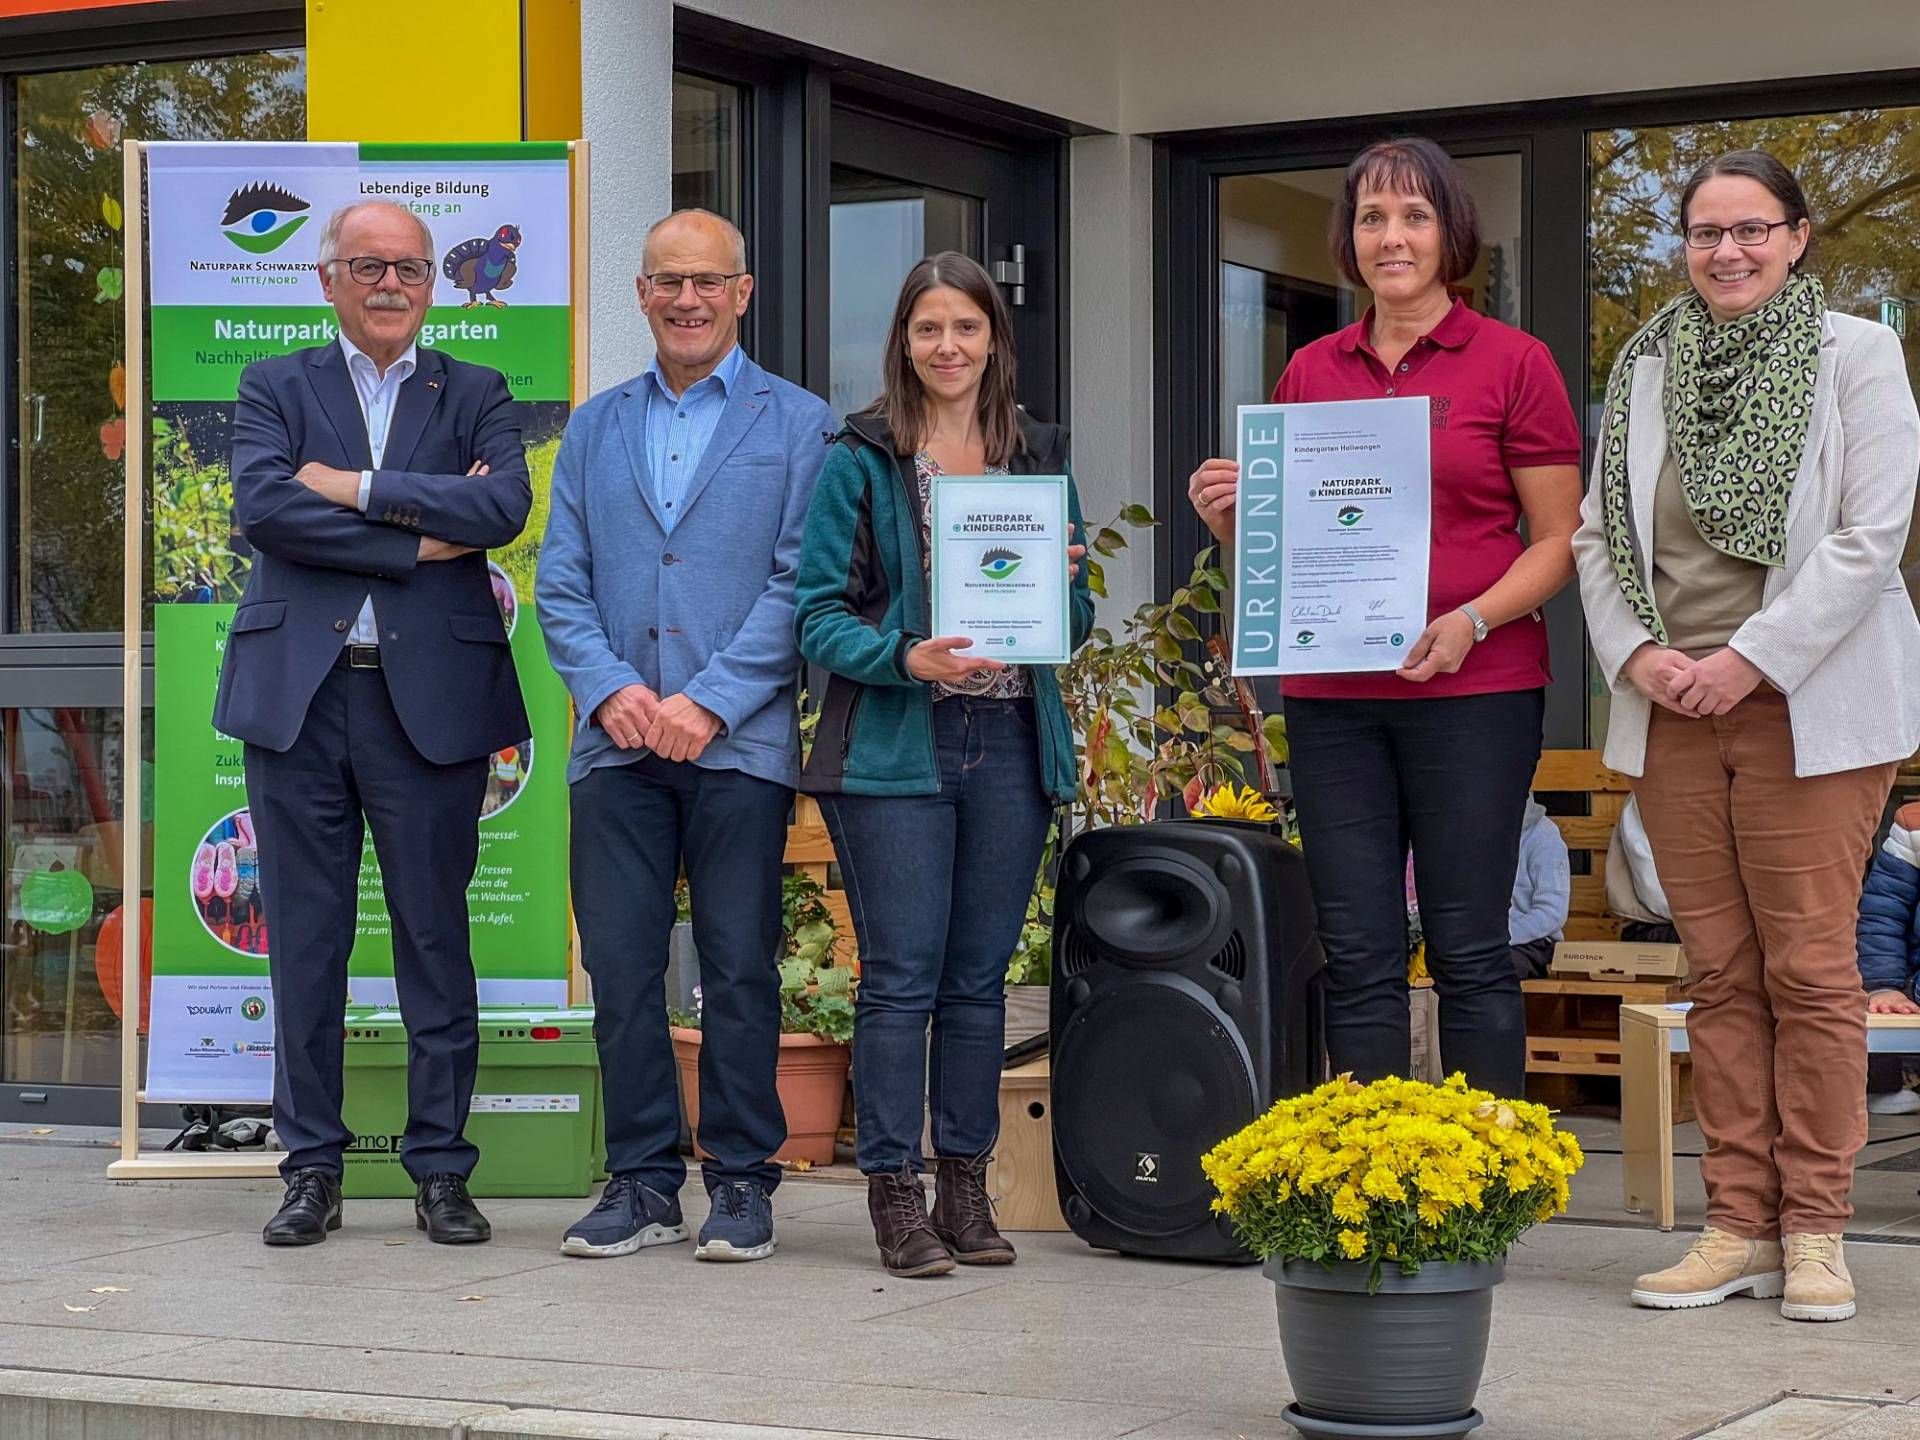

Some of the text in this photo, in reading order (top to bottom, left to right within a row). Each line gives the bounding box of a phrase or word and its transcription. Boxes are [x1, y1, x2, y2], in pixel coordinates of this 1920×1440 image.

[360, 181, 490, 198] Lebendige Bildung
[394, 201, 462, 217] nfang an
[231, 276, 298, 286] MITTE/NORD
[1294, 445, 1339, 454] Kindergarten
[1321, 477, 1382, 488] NATURPARK
[1318, 486, 1392, 497] KINDERGARTEN
[966, 513, 1033, 523] NATURPARK
[962, 523, 1045, 533] KINDERGARTEN
[1243, 426, 1279, 654] URKUNDE
[479, 863, 513, 877] fressen
[493, 878, 509, 888] die
[487, 911, 515, 925] Äpfel,
[199, 1003, 233, 1015] DURAVIT
